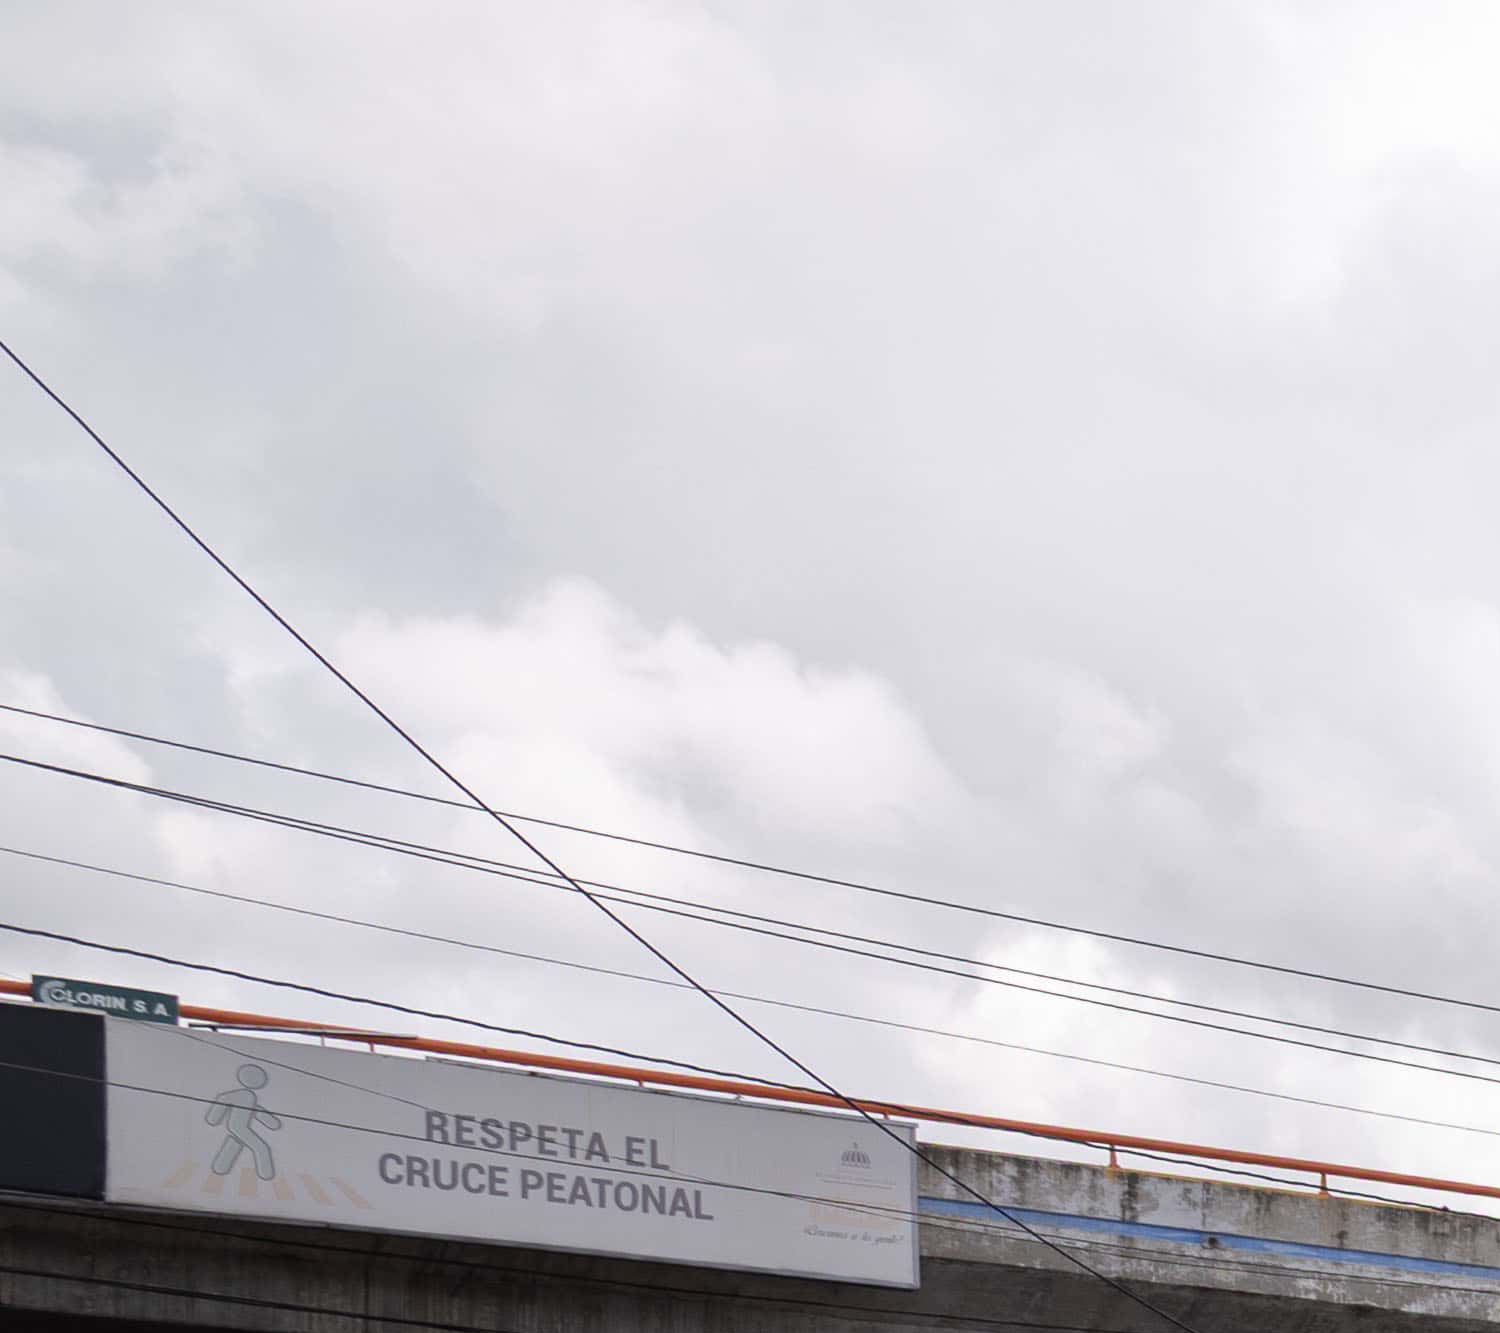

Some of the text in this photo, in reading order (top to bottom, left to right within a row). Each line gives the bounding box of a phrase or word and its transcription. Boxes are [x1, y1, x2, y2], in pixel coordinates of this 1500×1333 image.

[425, 1110, 670, 1170] RESPETA EL
[378, 1153, 715, 1221] CRUCE PEATONAL
